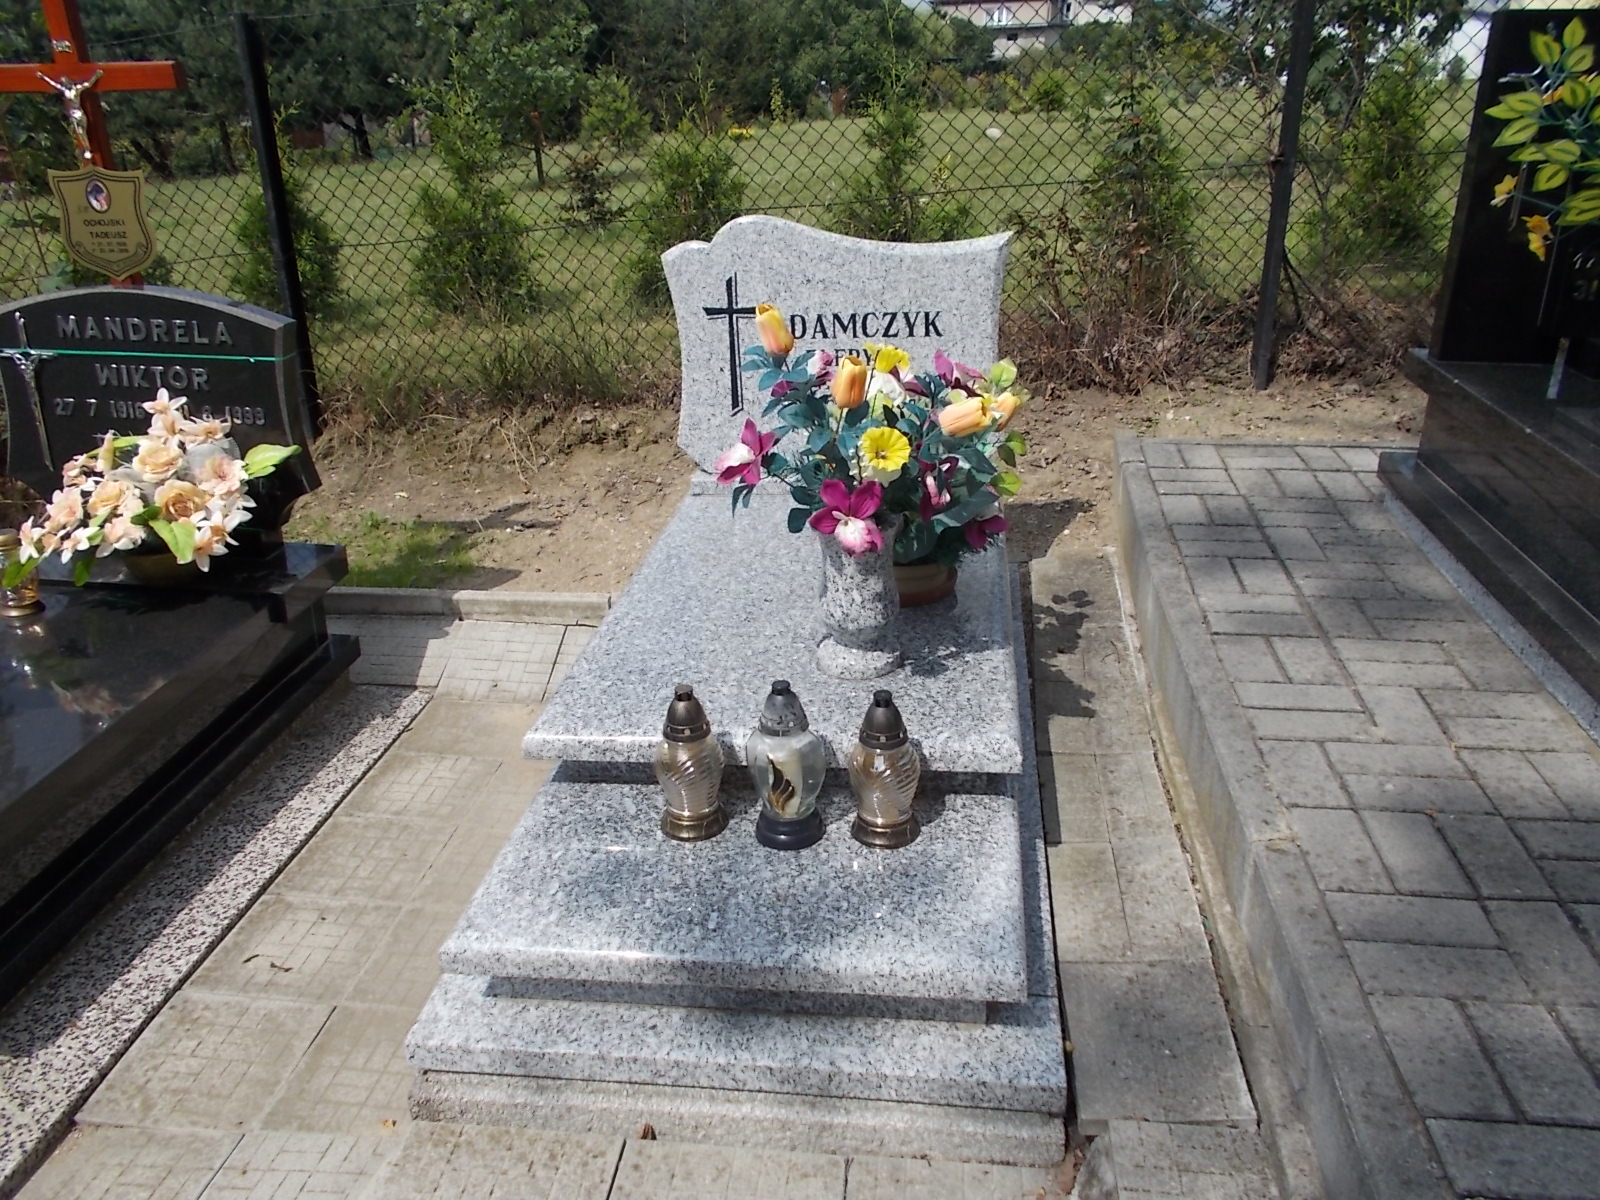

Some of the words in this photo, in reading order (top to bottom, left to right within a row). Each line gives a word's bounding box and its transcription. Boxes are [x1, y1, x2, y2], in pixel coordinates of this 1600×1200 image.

[90, 231, 128, 239] TADEUSZ
[57, 314, 234, 345] MANDRELA
[789, 310, 944, 340] DAMCZYK
[95, 362, 210, 392] WIKTOR
[54, 397, 75, 417] 27
[86, 398, 98, 417] 7
